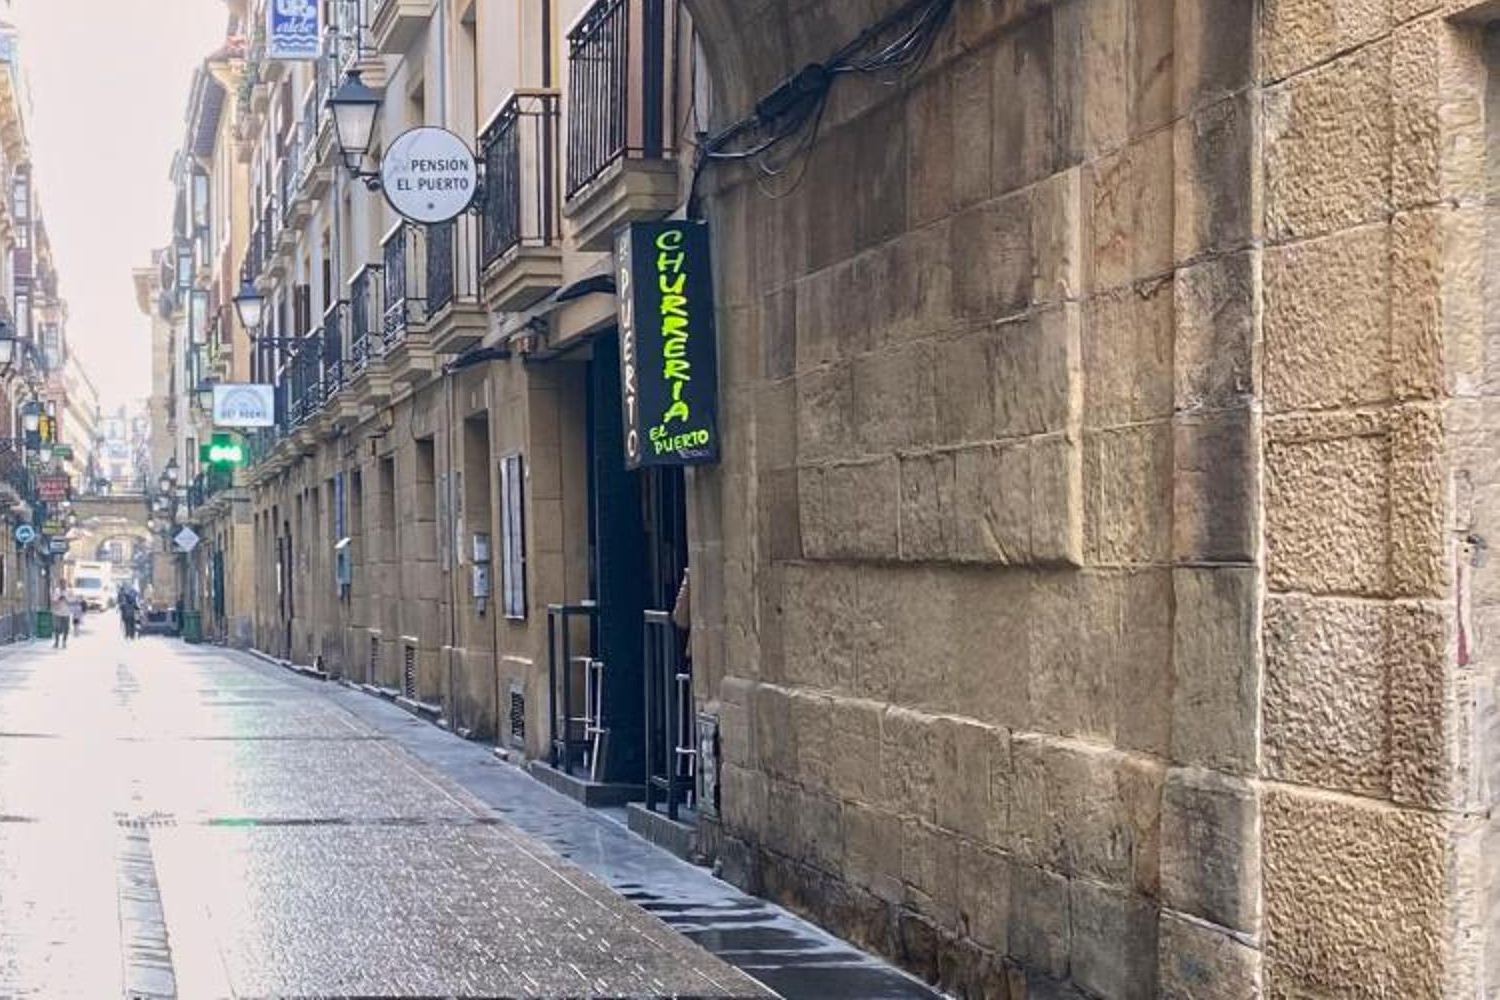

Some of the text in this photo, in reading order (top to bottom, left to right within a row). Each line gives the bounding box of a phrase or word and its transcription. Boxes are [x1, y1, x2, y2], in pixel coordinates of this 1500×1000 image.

[397, 178, 469, 191] EL PUERTO
[620, 267, 638, 457] PUERTO
[655, 229, 690, 423] CHURRERIA
[654, 429, 709, 454] PUERTO
